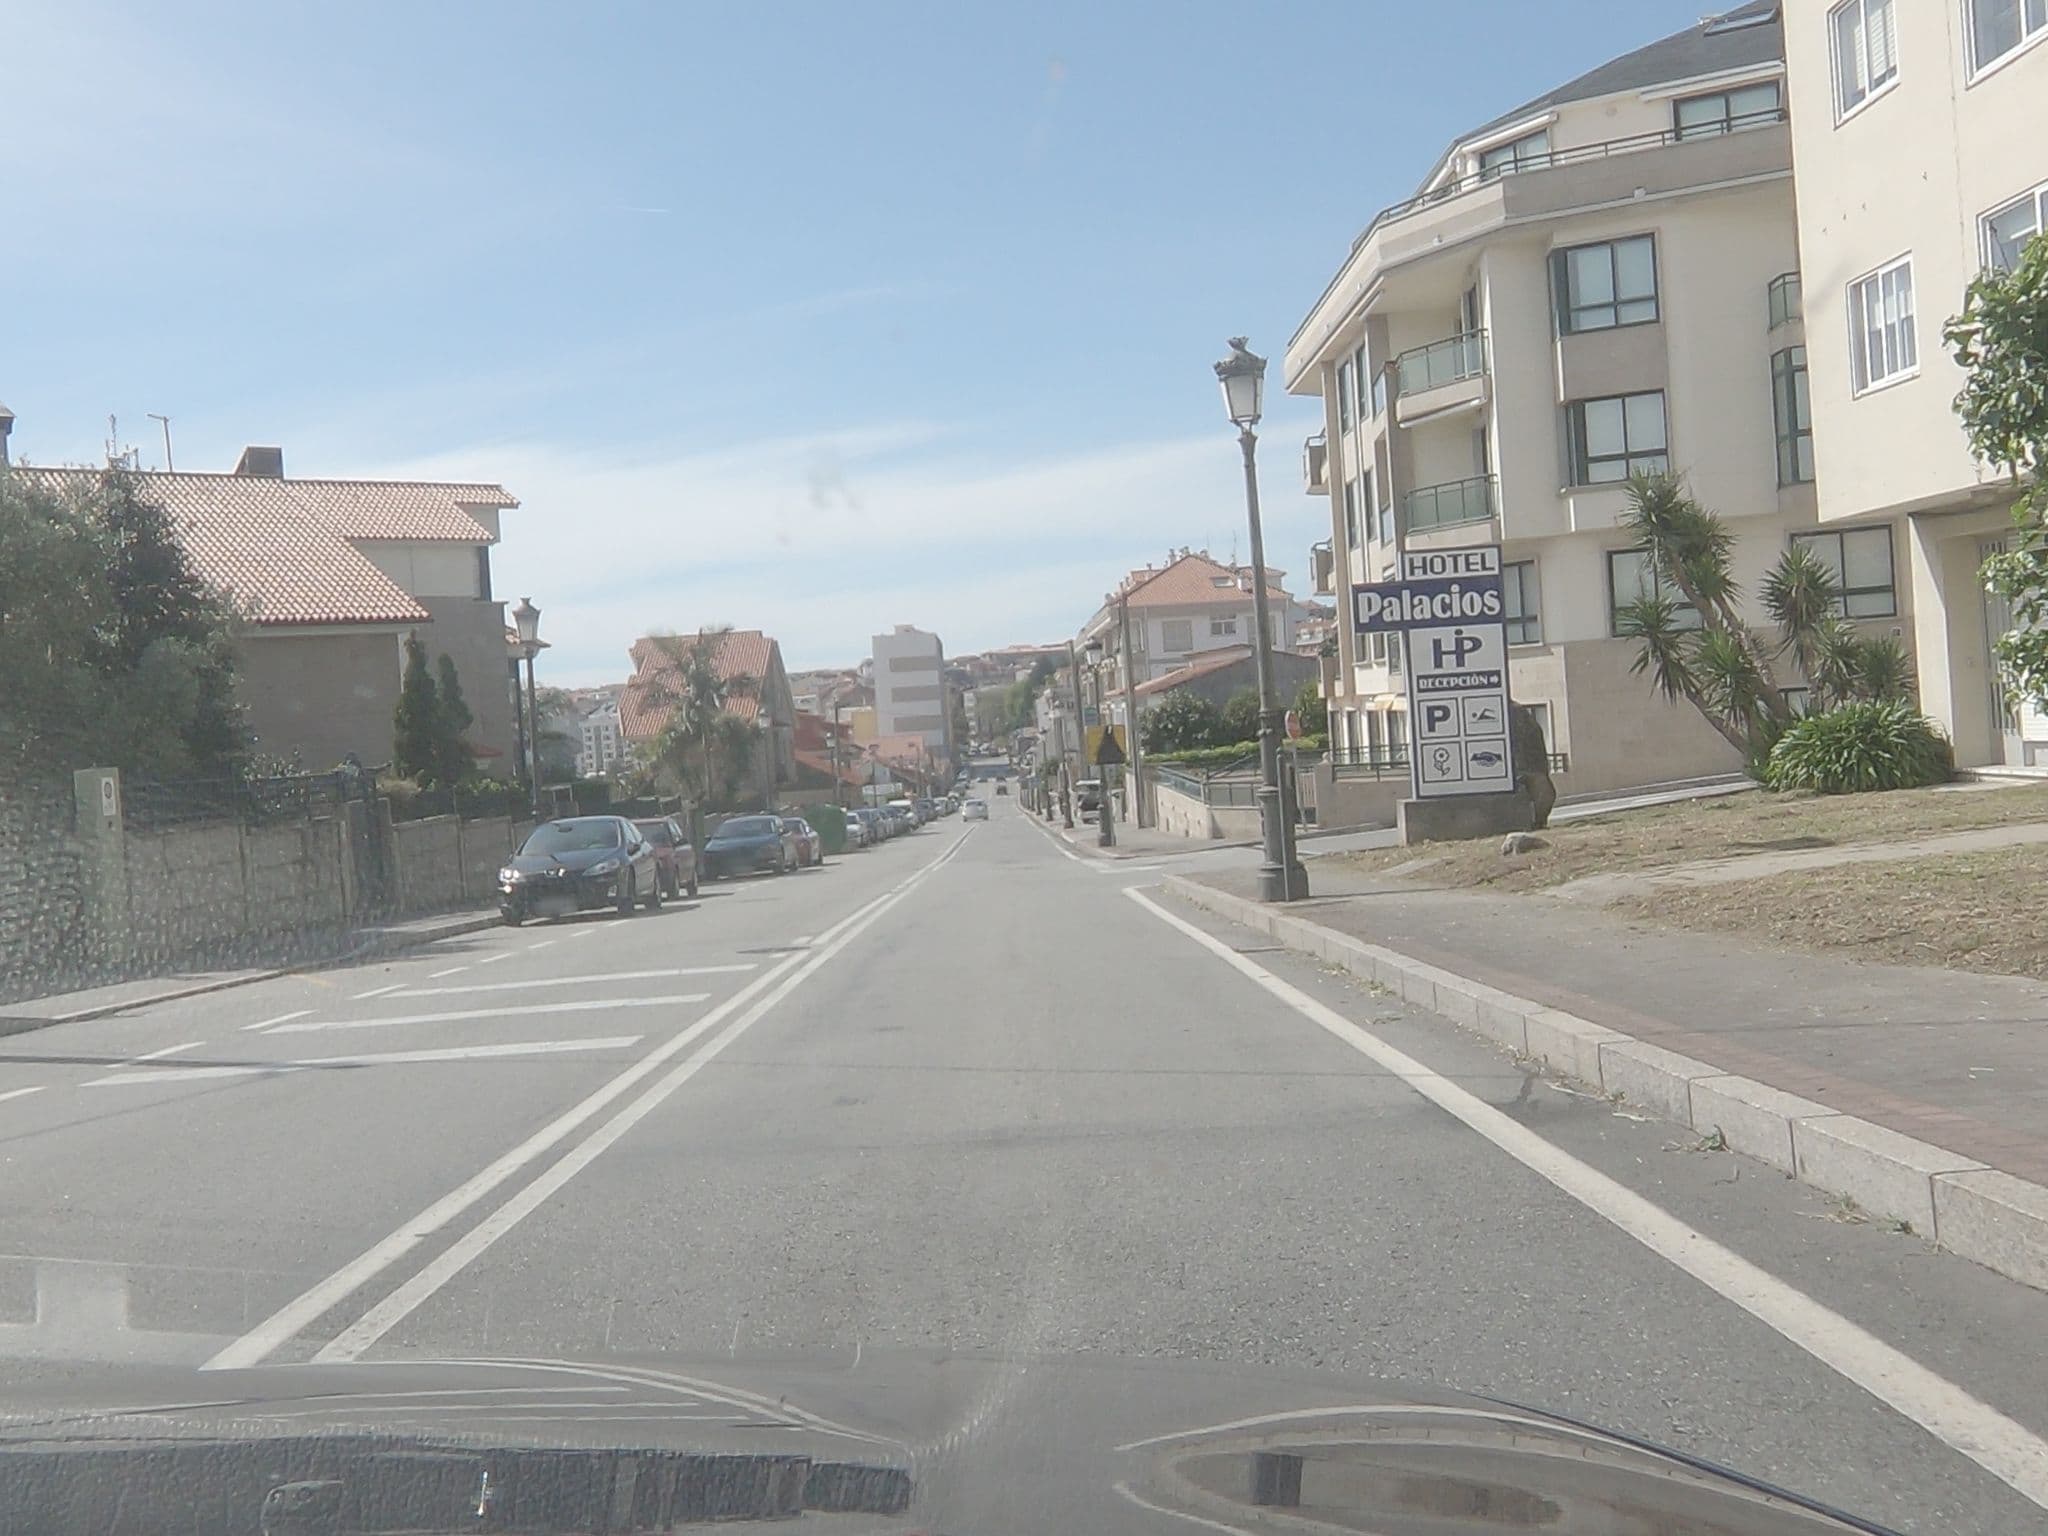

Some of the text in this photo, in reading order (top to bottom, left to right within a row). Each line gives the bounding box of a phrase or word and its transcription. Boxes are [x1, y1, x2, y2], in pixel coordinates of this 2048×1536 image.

[1409, 553, 1495, 576] HOTEL
[1357, 584, 1501, 624] Palacios
[1426, 705, 1451, 733] P
